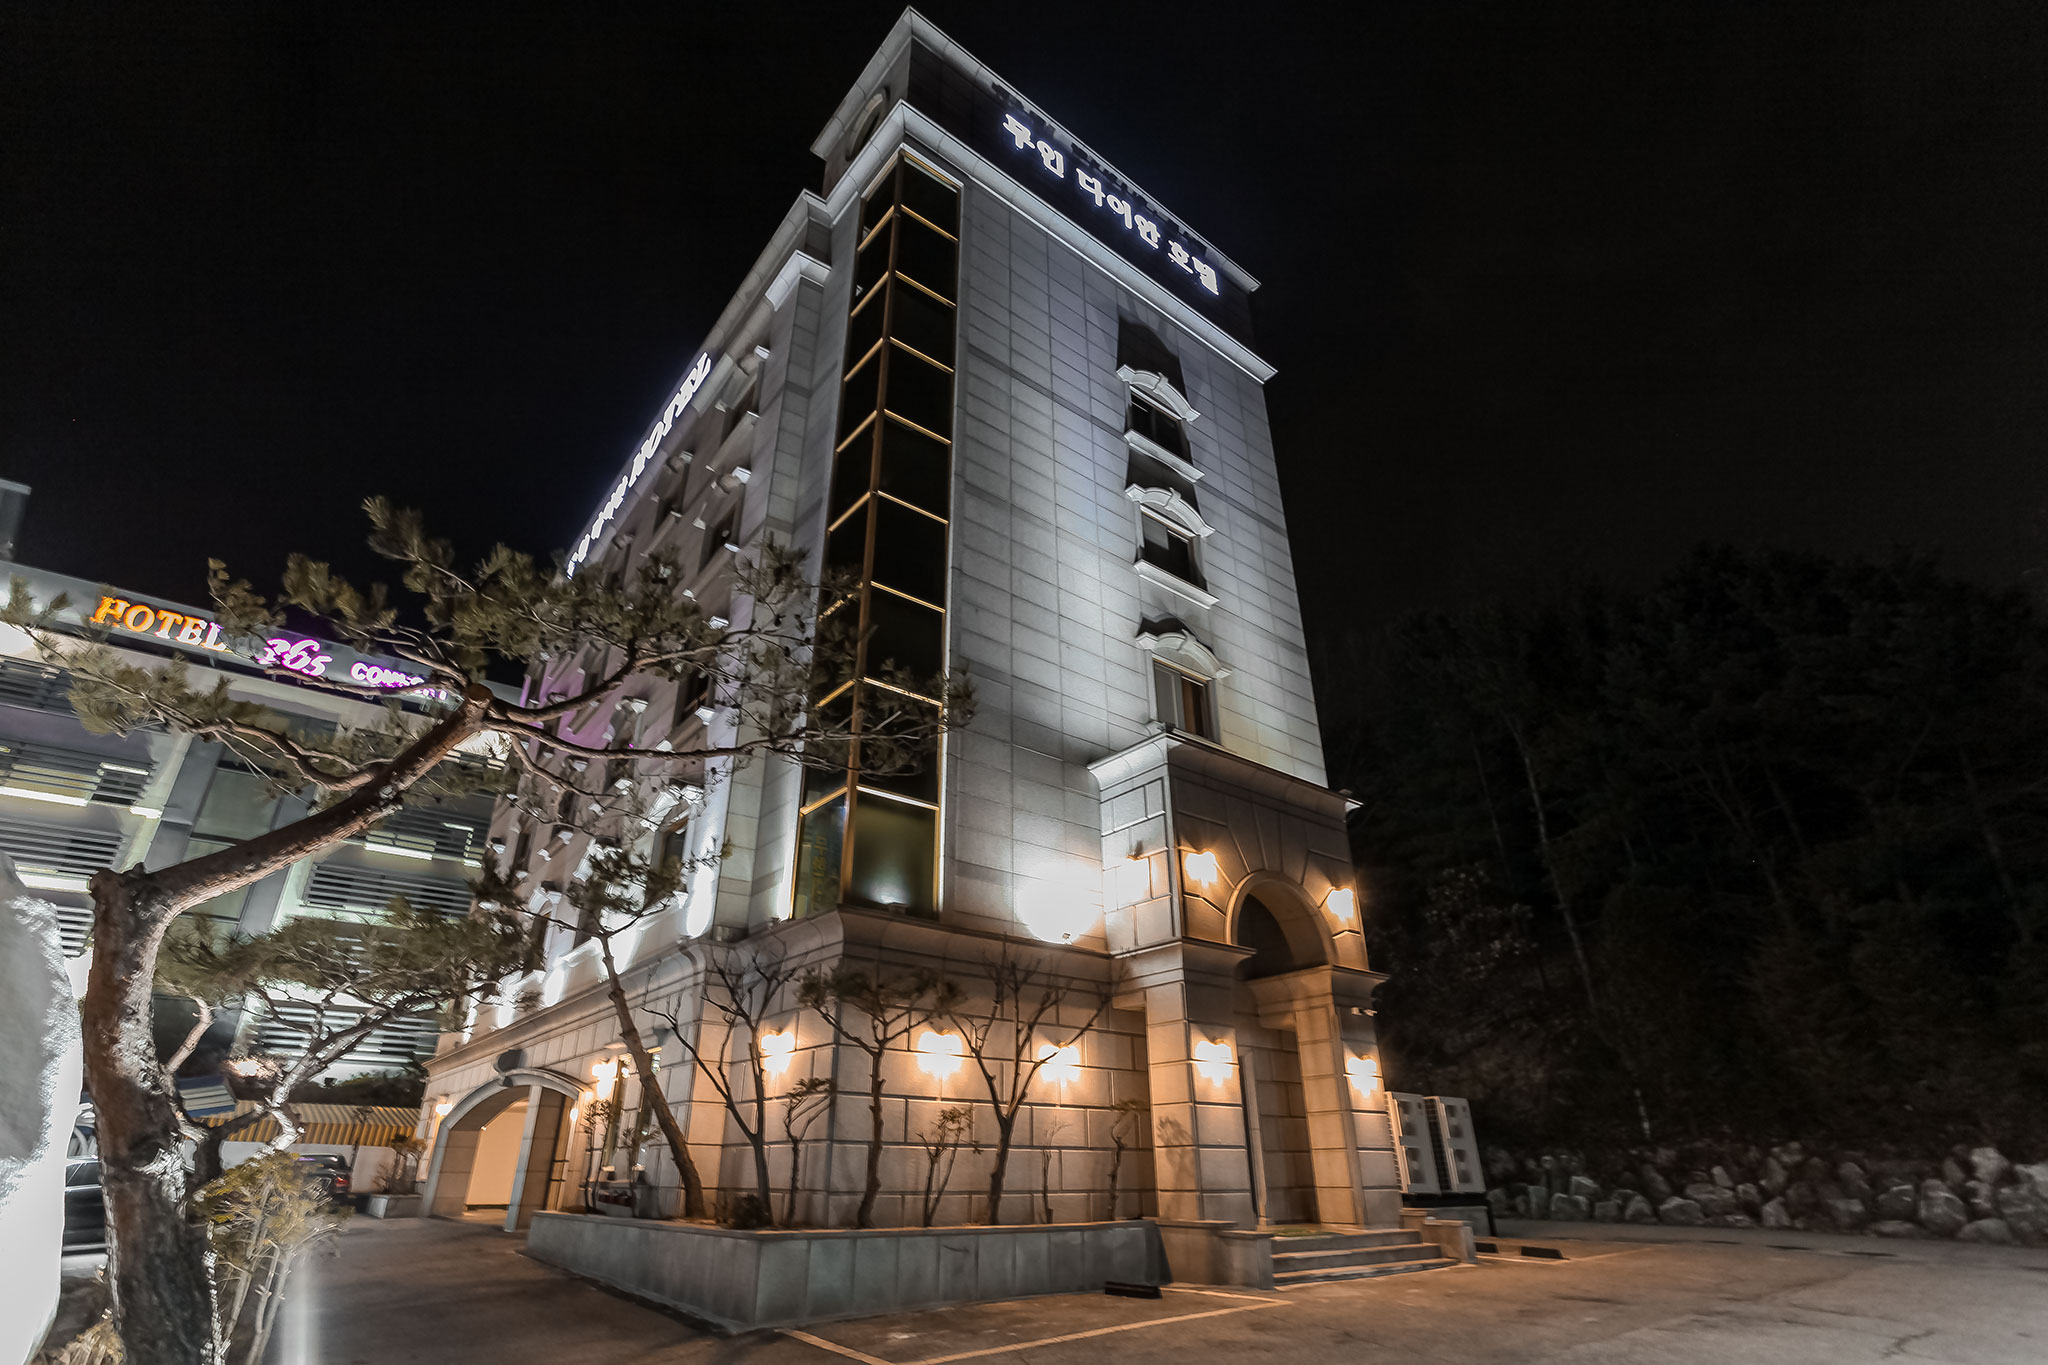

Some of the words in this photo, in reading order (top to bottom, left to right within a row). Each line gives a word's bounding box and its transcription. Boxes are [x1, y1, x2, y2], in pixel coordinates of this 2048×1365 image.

[1003, 114, 1064, 178] 무인
[1076, 168, 1161, 249] 다이안
[1168, 240, 1219, 295] 호텔
[90, 596, 227, 653] HOTEL
[257, 638, 333, 677] 365
